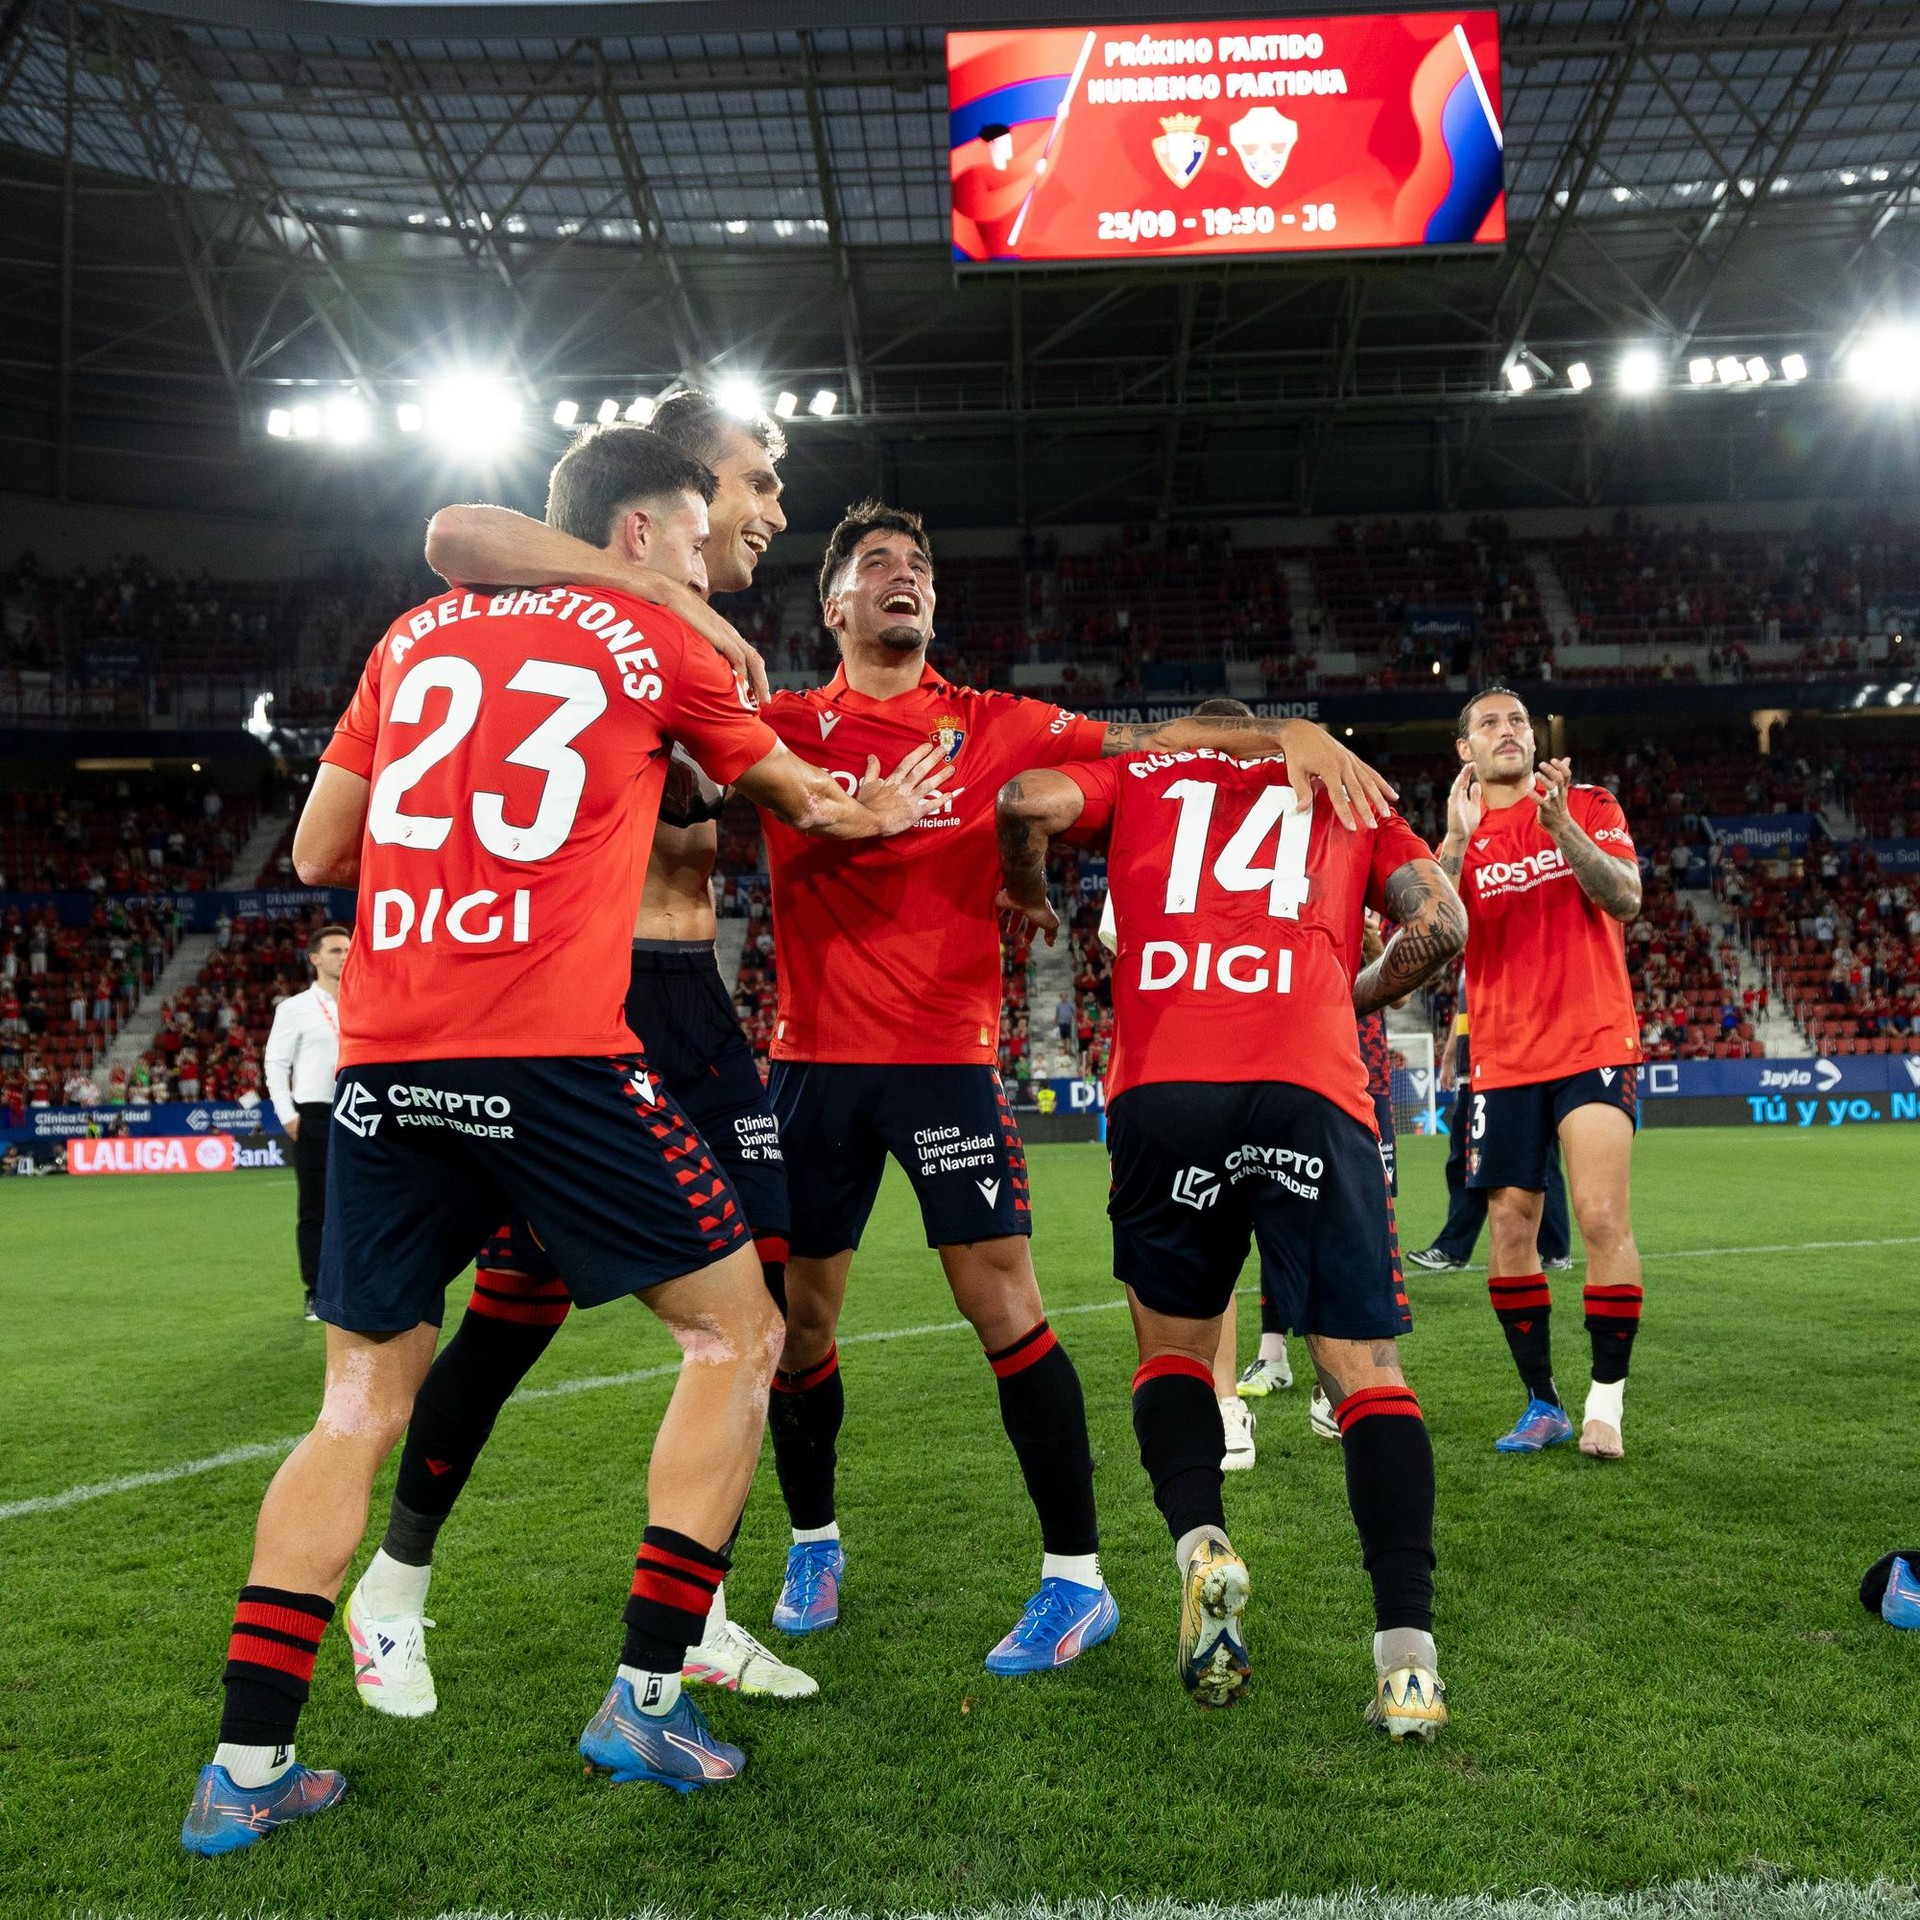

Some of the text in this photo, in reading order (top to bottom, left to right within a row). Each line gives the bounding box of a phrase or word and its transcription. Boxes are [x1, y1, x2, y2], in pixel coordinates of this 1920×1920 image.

[1104, 33, 1323, 67] PRÓXIMO PARTIDO
[1226, 69, 1348, 99] PARTIDUA
[1098, 209, 1176, 242] 25/09
[1201, 206, 1275, 236] 19:30
[1302, 203, 1337, 232] J6
[390, 588, 663, 701] ABEL BRETONES
[1074, 707, 1143, 724] SUNA
[1148, 706, 1193, 721] NUN
[1256, 702, 1319, 719] RINDE
[368, 655, 608, 863] 23
[1161, 779, 1314, 921] 14
[1080, 873, 1109, 890] cle
[372, 888, 531, 951] DIGI
[1138, 941, 1292, 993] DIGI
[387, 1084, 511, 1119] CRYPTO
[1070, 1081, 1105, 1108] DI
[1747, 1092, 1920, 1128] Tú y yo. N
[396, 1114, 515, 1139] FUND TRADER
[1472, 1094, 1486, 1140] 3
[914, 1126, 960, 1145] Clínica
[917, 1133, 995, 1160] Universidad
[73, 1140, 188, 1171] LALIGA
[741, 1147, 759, 1160] de
[921, 1153, 995, 1176] de Navarra
[1225, 1144, 1324, 1180] CRYPTO
[1230, 1165, 1320, 1200] FUND TRADER
